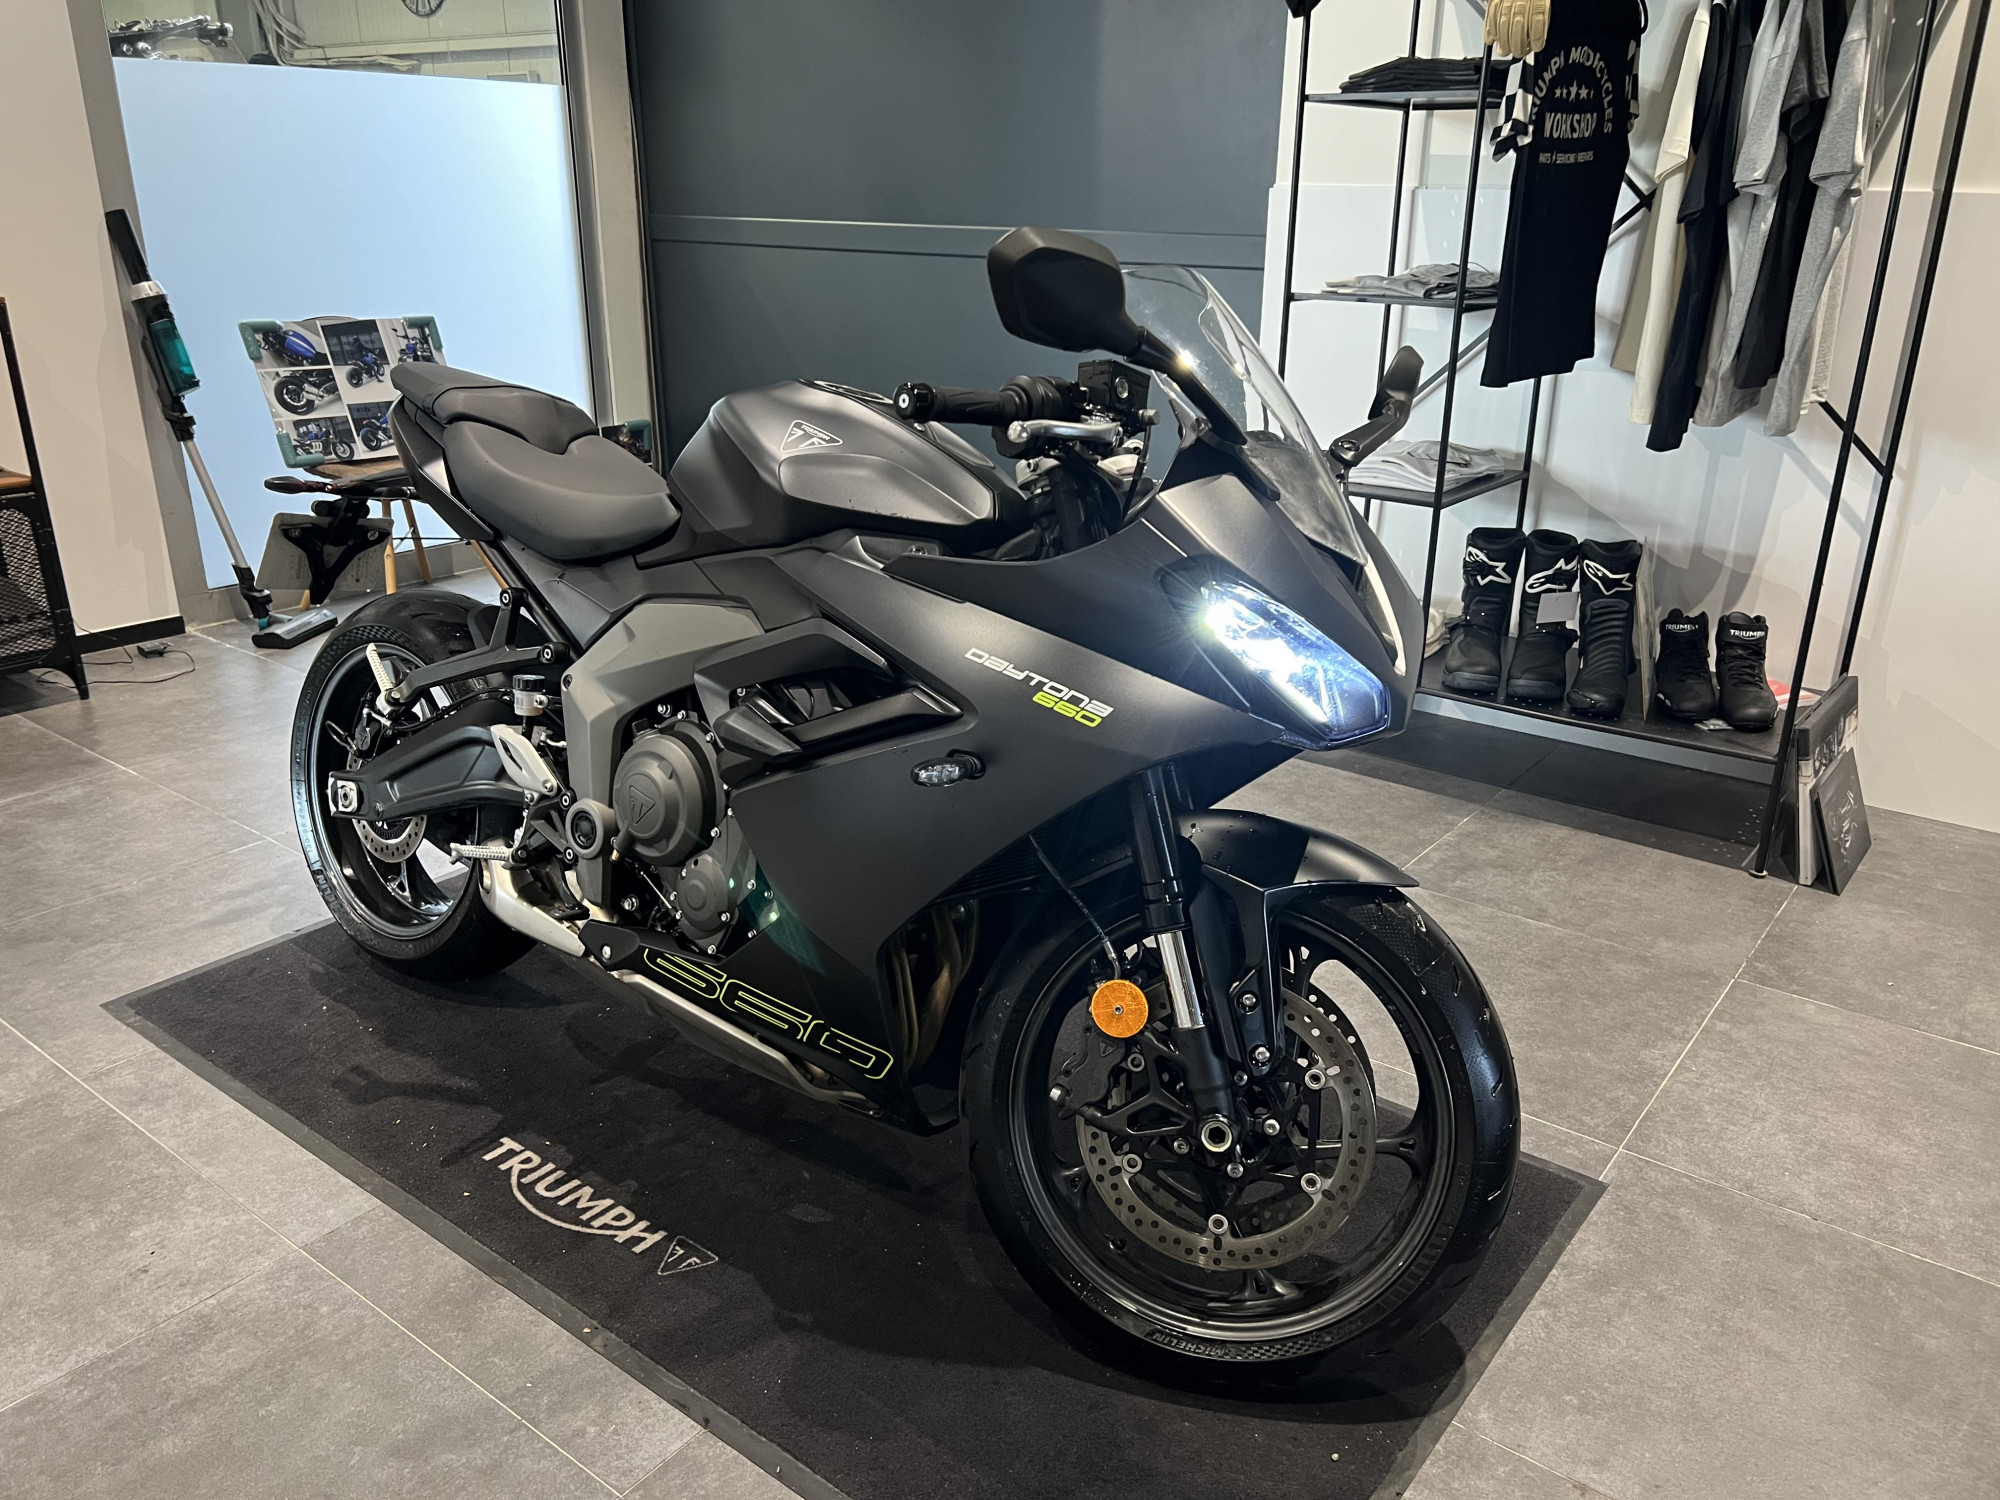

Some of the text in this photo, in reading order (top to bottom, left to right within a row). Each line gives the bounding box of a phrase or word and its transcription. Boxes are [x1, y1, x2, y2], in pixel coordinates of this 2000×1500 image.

[1032, 690, 1103, 728] 660
[643, 949, 894, 1080] 660
[482, 1137, 668, 1254] TRIUMPH
[1153, 1332, 1226, 1357] MICHELIN
